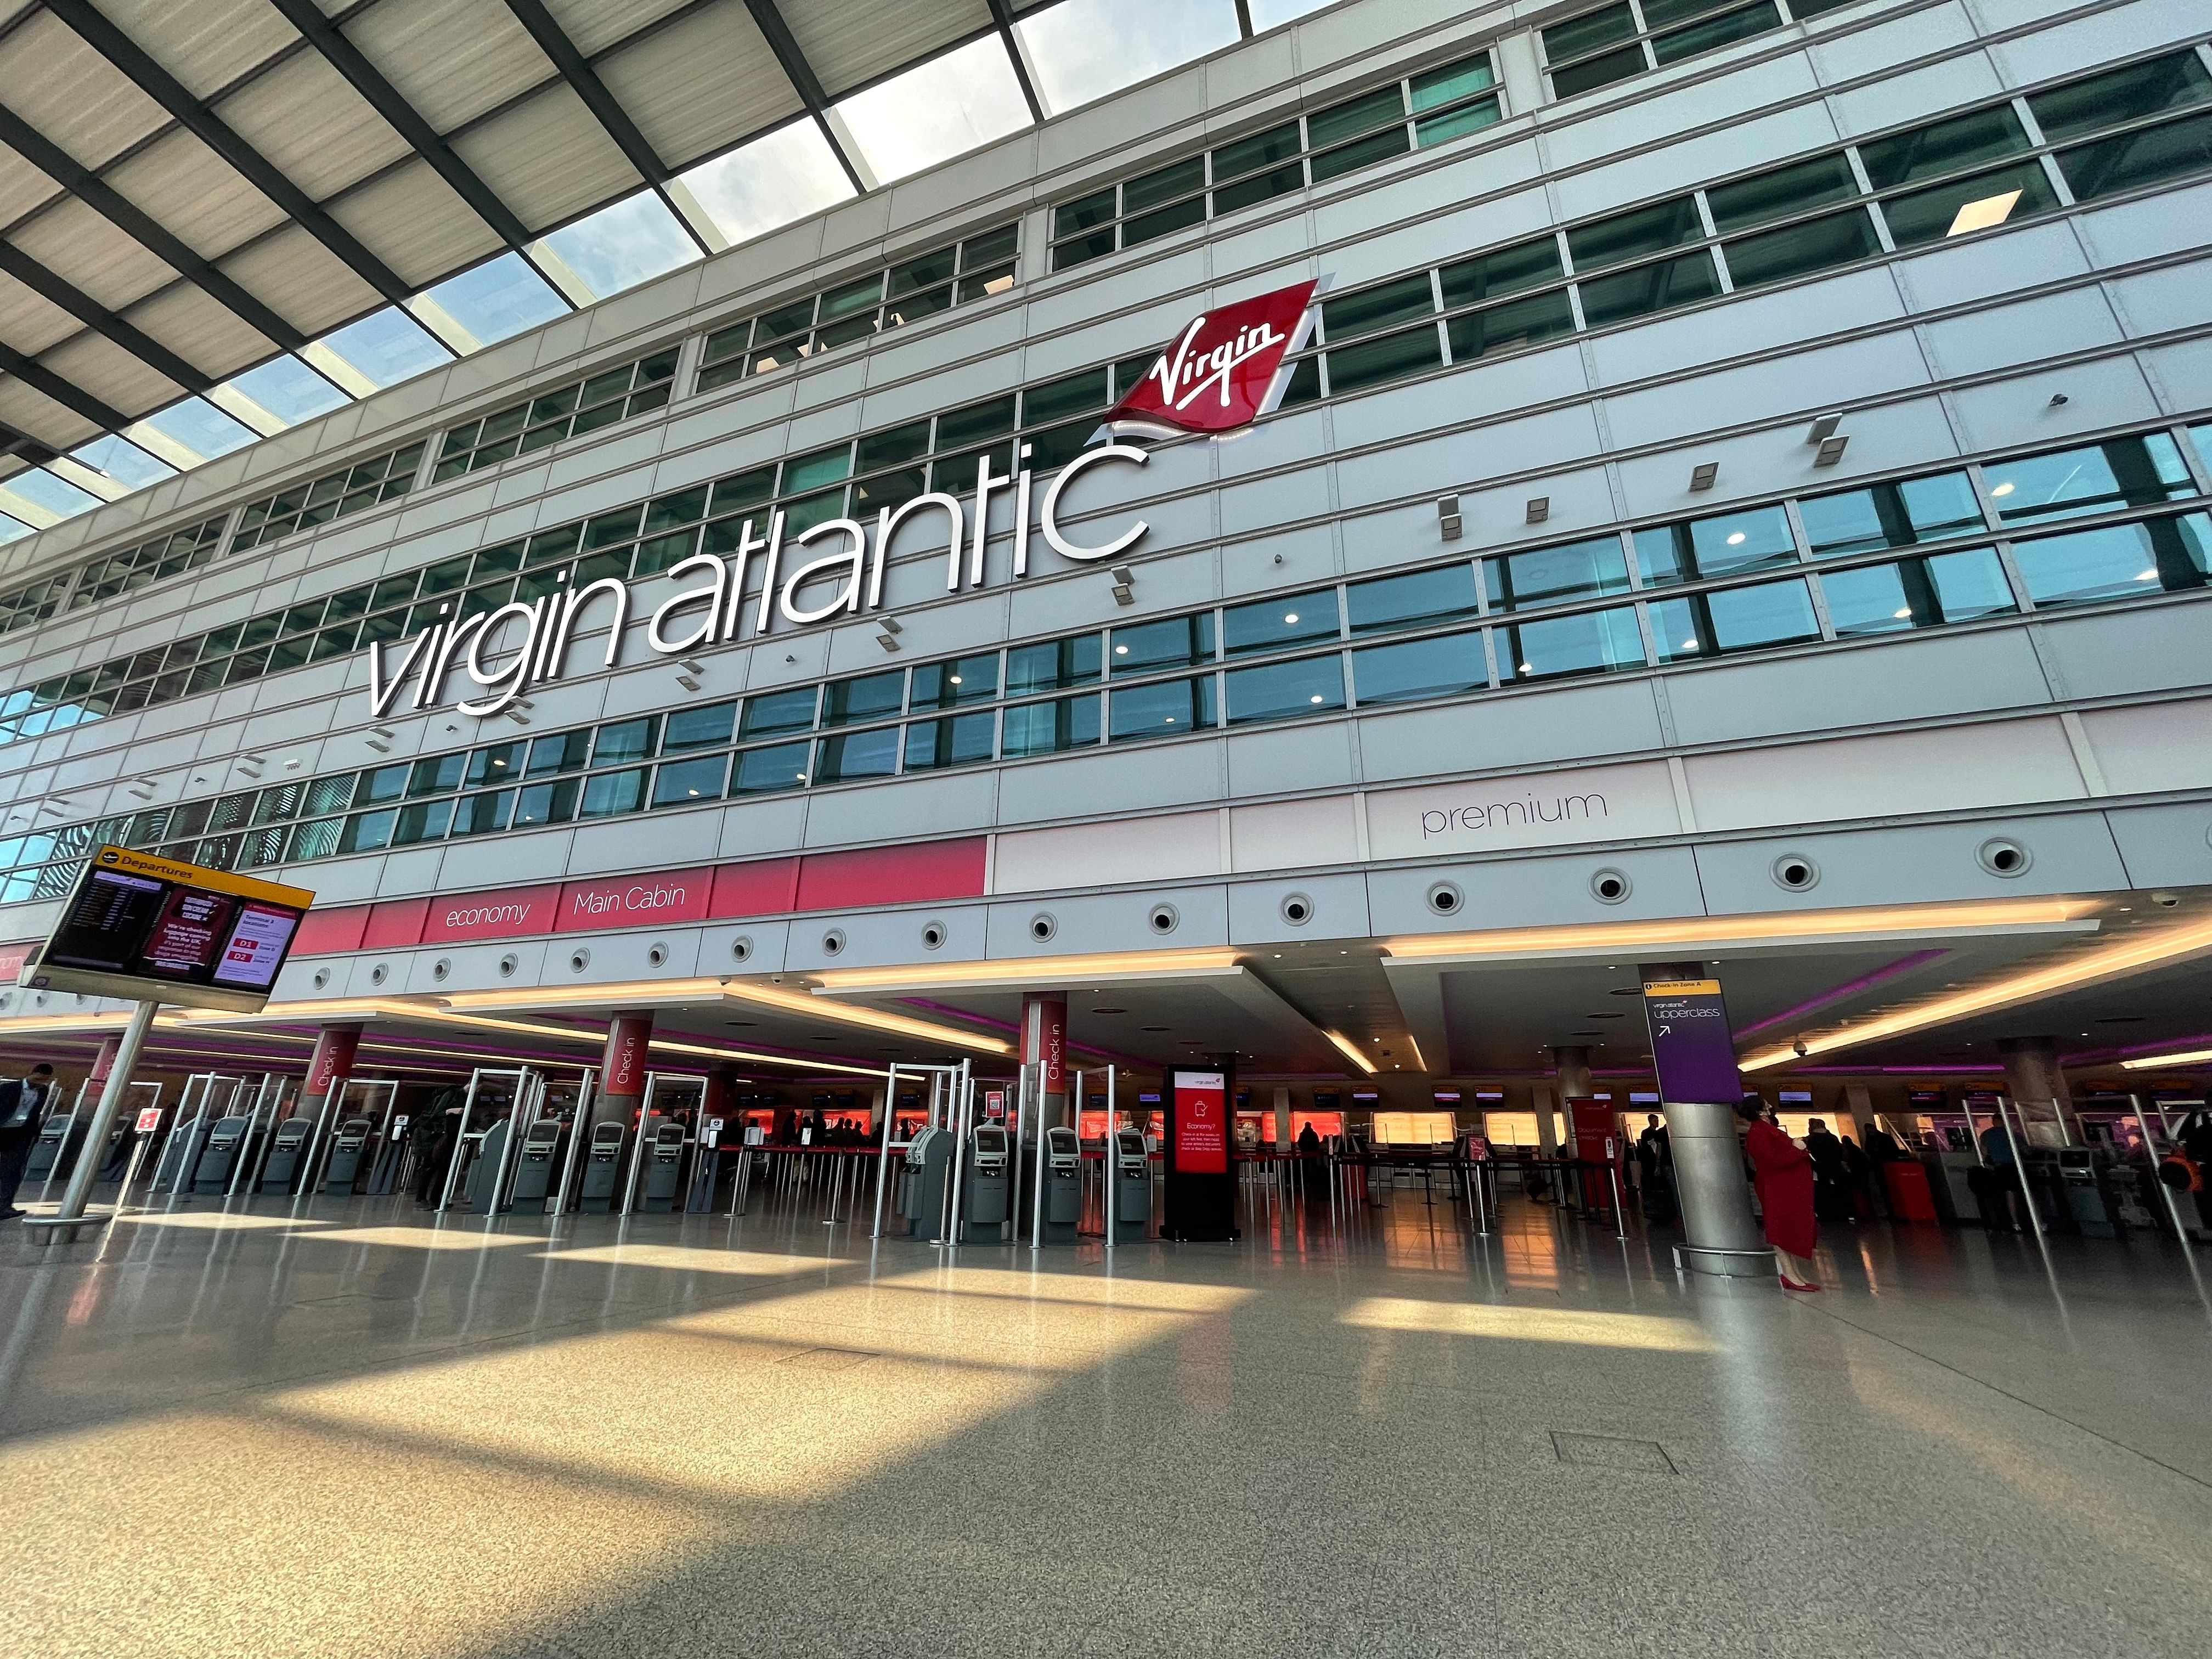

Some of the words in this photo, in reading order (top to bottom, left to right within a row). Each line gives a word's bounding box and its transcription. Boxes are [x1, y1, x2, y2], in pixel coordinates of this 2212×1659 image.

[1149, 317, 1285, 410] Virgin
[370, 570, 629, 718] virgin
[647, 443, 1150, 654] atlantic
[1422, 792, 1607, 840] premium
[121, 856, 194, 879] Departures
[573, 890, 620, 915] Main
[625, 883, 685, 910] Cabin
[445, 903, 531, 927] economy
[1654, 1007, 1720, 1020] upperclass
[624, 1037, 635, 1047] in
[1050, 1024, 1060, 1035] in
[326, 1046, 339, 1054] in
[1048, 1039, 1059, 1080] Check
[318, 1057, 335, 1086] Check
[617, 1049, 633, 1084] Check
[1187, 1122, 1216, 1131] Economy?
